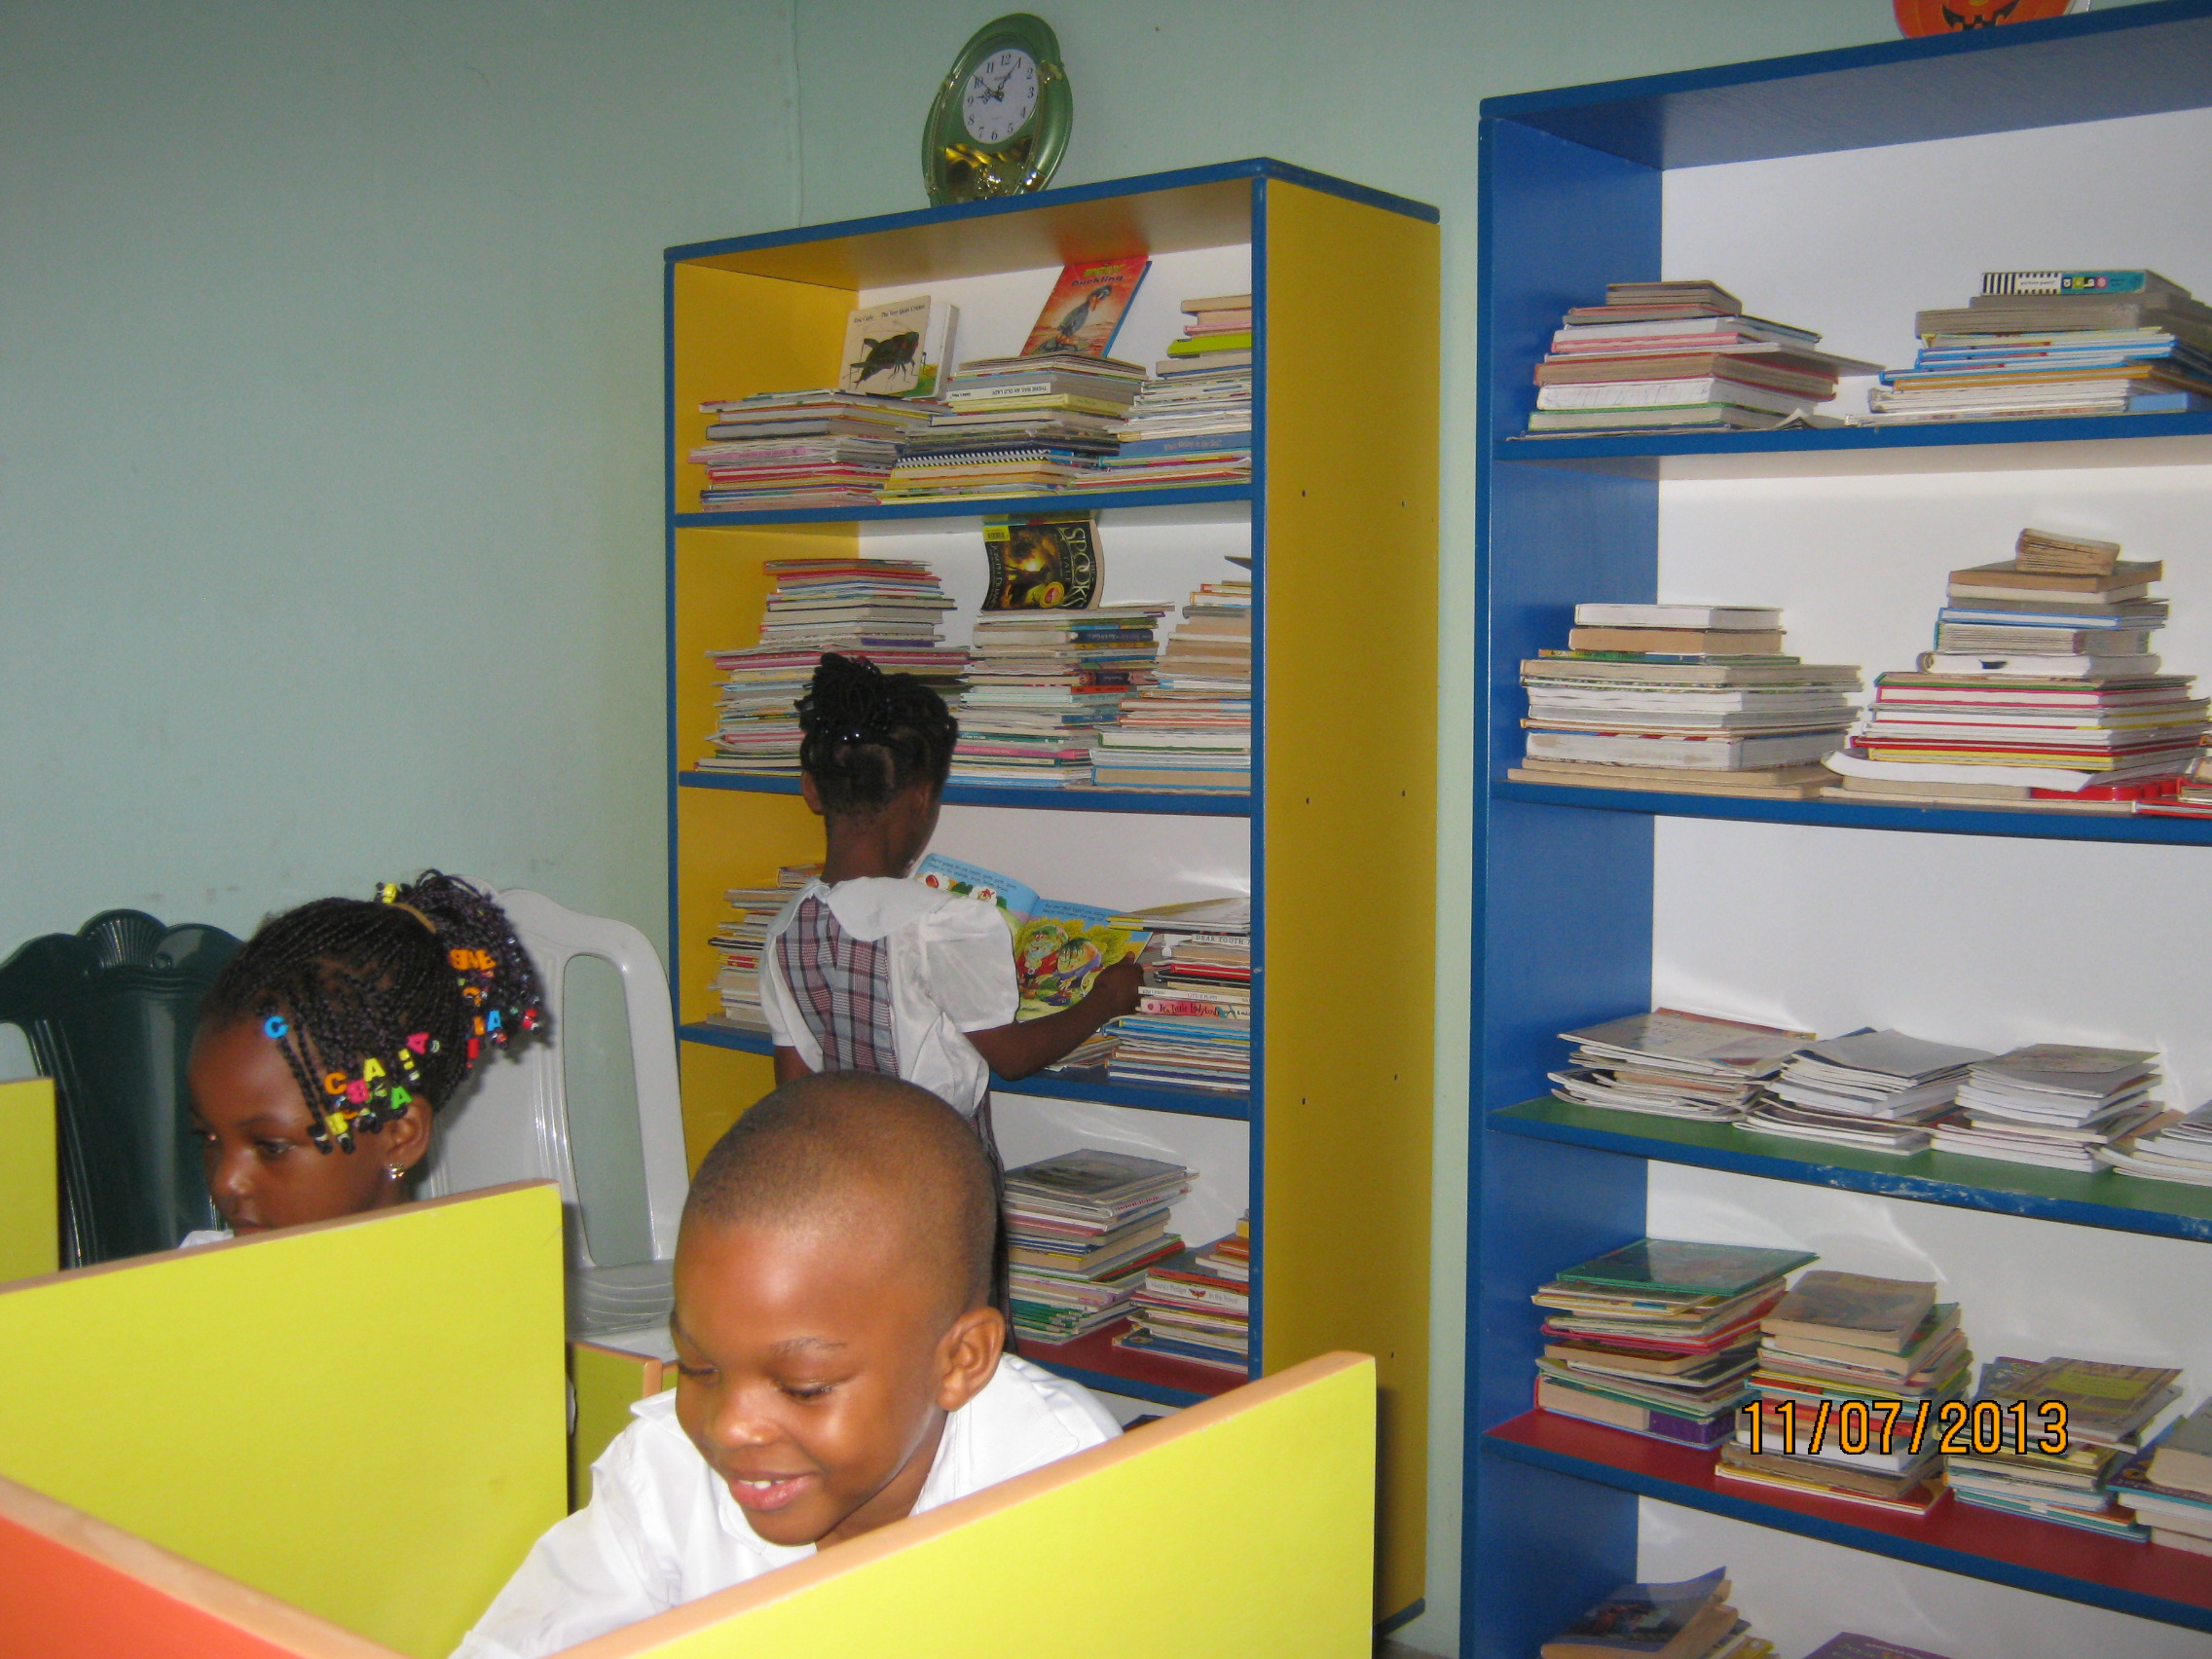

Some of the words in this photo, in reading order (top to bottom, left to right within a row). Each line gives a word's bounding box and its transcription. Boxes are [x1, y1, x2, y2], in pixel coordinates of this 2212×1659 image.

[1001, 54, 1012, 66] 12
[1016, 56, 1022, 69] 1
[986, 61, 994, 74] 11
[1025, 67, 1034, 80] 2
[974, 76, 984, 90] 10
[1027, 86, 1035, 99] 3
[967, 97, 975, 108] 9
[1020, 106, 1027, 119] 4
[968, 114, 976, 127] 8
[978, 126, 985, 138] 7
[1007, 122, 1014, 134] 5
[991, 130, 999, 141] 6
[1072, 275, 1124, 286] Duckling
[1218, 936, 1244, 945] TOOTH
[1160, 1003, 1170, 1014] Ten
[1171, 1003, 1188, 1014] Little
